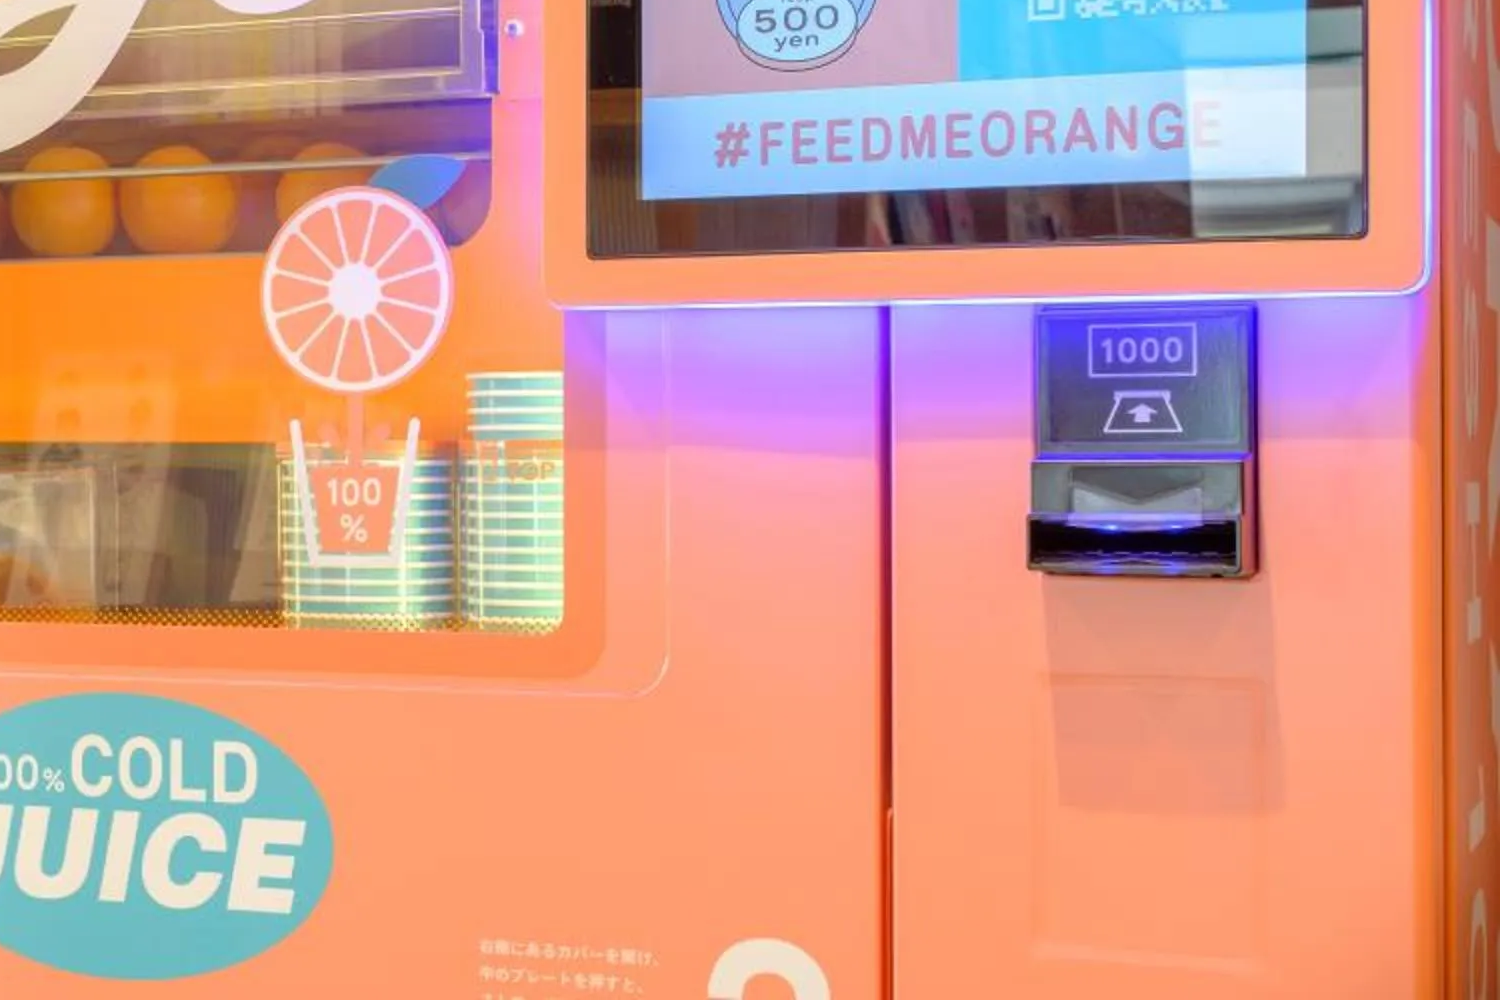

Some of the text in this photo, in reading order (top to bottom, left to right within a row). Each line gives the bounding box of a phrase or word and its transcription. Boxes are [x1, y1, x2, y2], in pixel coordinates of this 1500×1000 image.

[754, 5, 840, 34] 500
[773, 33, 820, 53] yen
[714, 101, 1221, 169] #FEEDMEORANGE
[1100, 336, 1183, 364] 1000
[327, 478, 382, 507] 100
[340, 513, 368, 543] %
[71, 733, 258, 804] COLD
